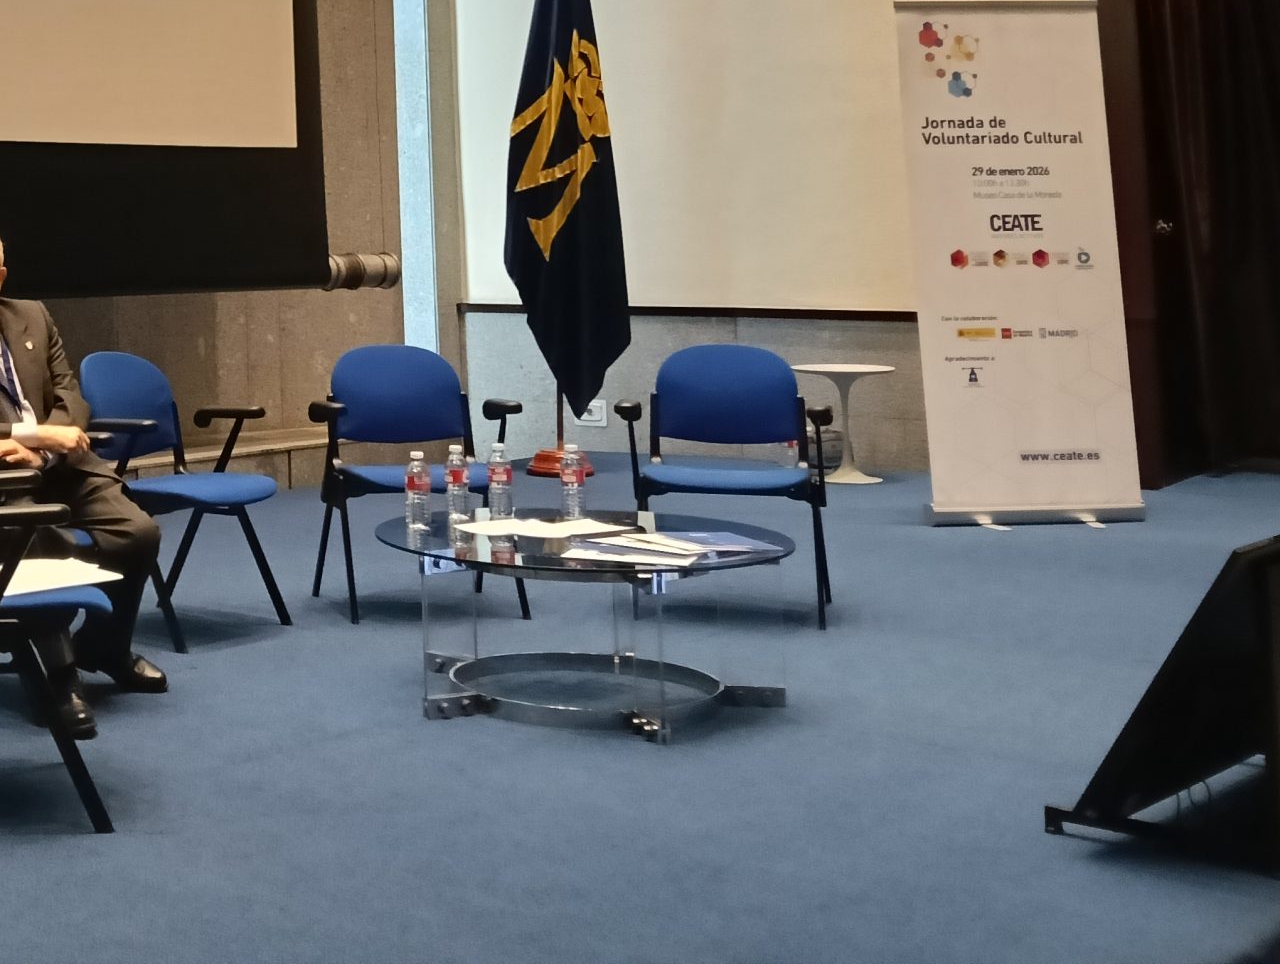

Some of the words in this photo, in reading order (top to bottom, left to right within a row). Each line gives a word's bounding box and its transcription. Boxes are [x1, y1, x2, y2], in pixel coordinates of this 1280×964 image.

[921, 117, 984, 129] Jornada
[989, 116, 1006, 129] de
[921, 132, 1020, 145] Voluntariado
[1023, 131, 1083, 144] Cultural
[971, 167, 983, 176] 29
[986, 167, 998, 176] de
[999, 168, 1025, 176] enero
[1026, 166, 1050, 176] 2026
[990, 214, 1043, 232] CEATE
[1048, 329, 1079, 337] MADRID
[1020, 451, 1100, 461] www.ceate.es
